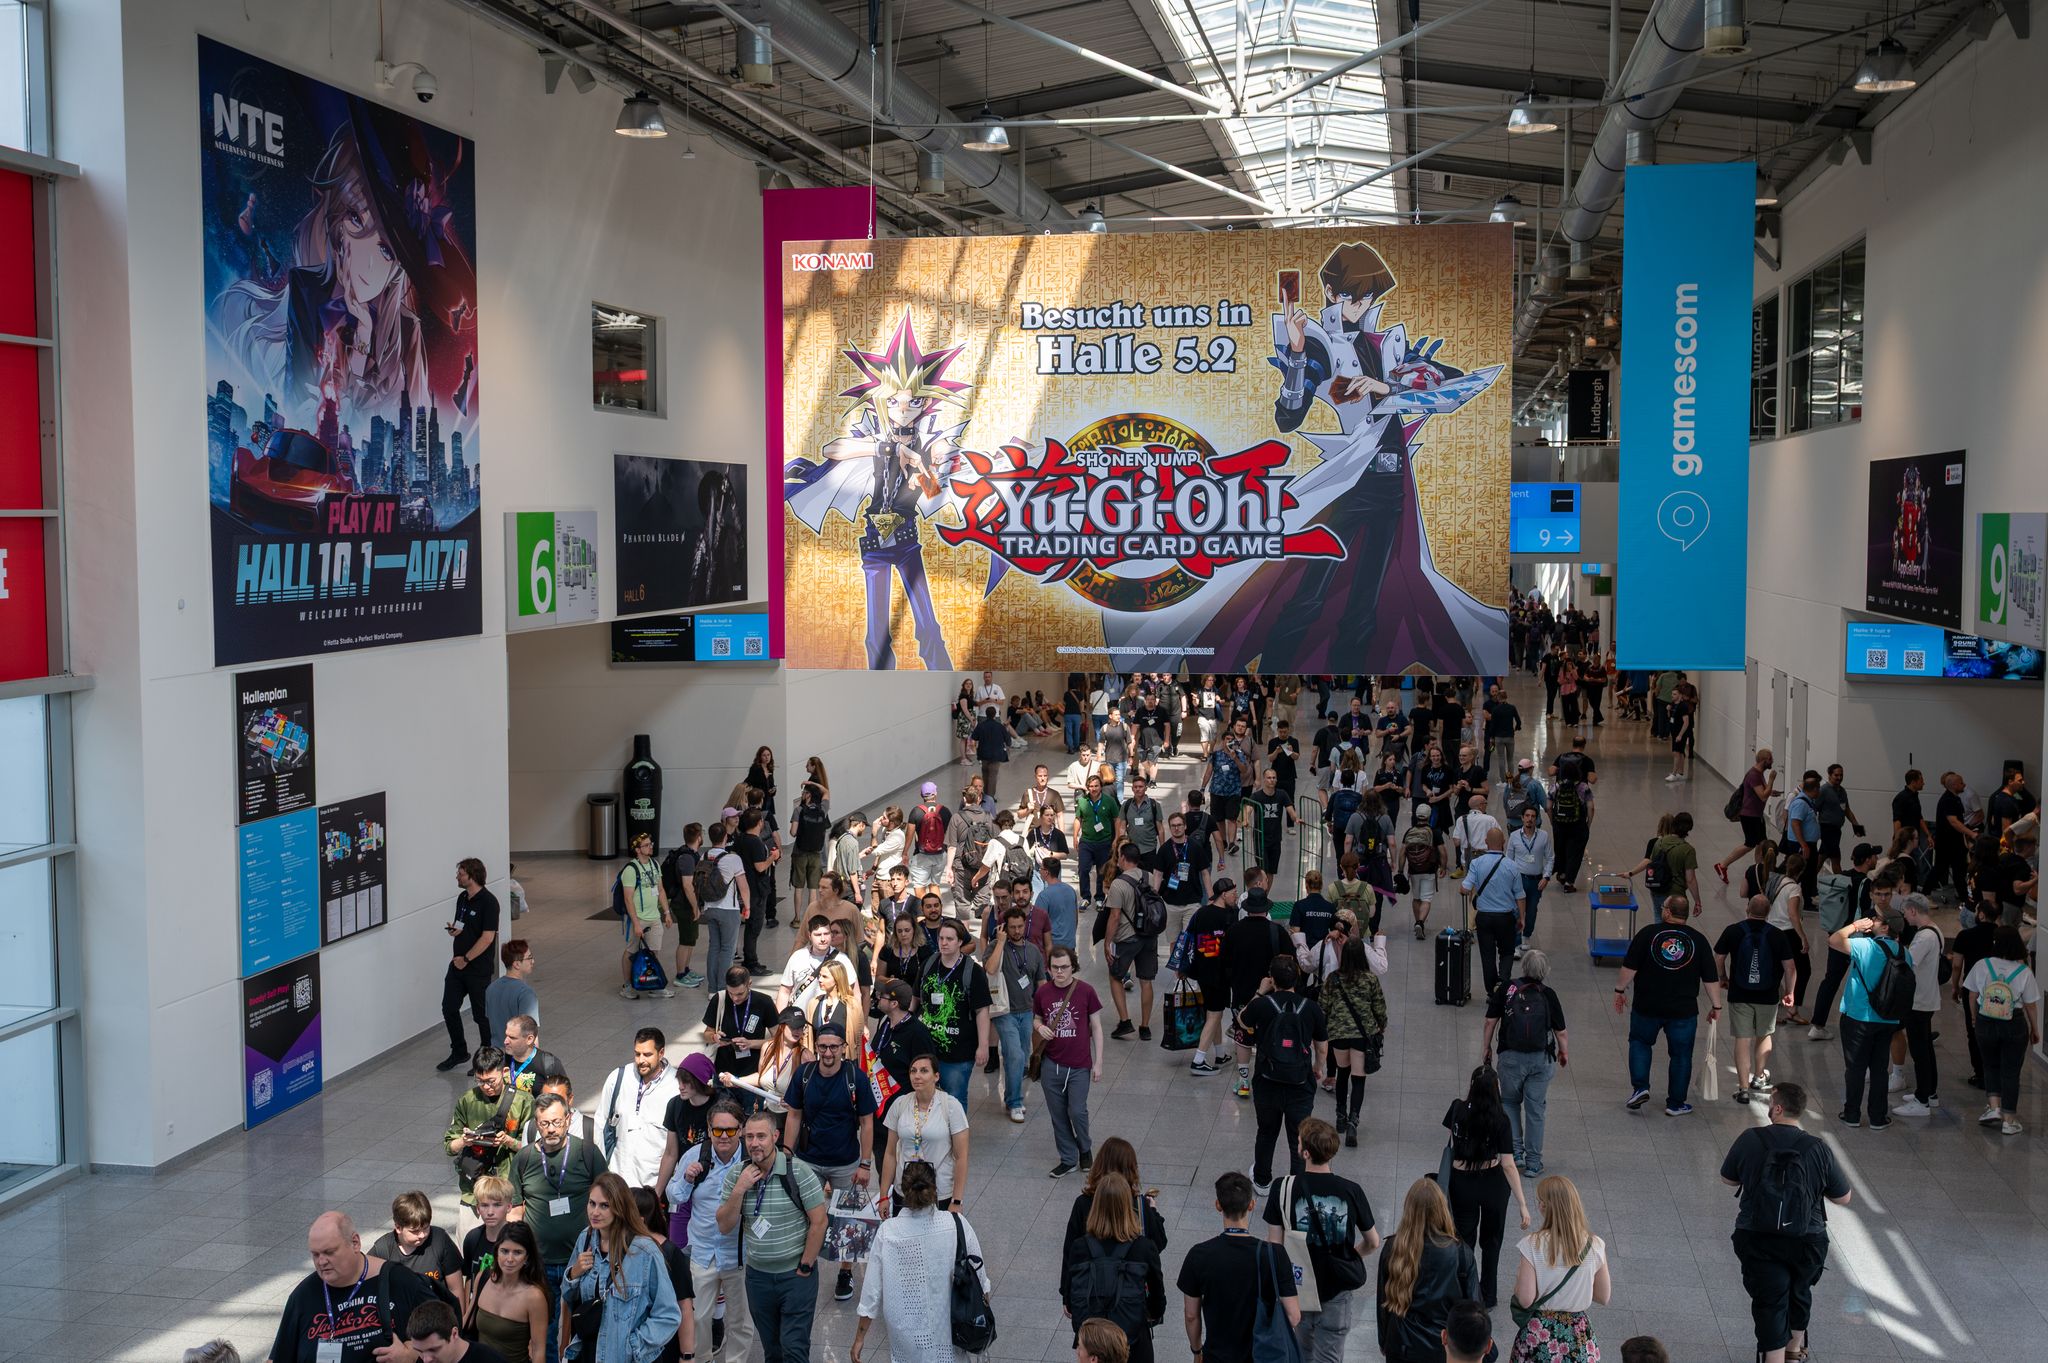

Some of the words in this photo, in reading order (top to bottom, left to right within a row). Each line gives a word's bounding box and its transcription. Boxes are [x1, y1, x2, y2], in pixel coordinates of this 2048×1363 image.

[213, 92, 285, 157] NTE
[214, 140, 247, 157] NEVERNESS
[248, 150, 256, 160] TO
[257, 153, 284, 168] EVERNESS
[792, 252, 874, 271] KONAMI
[1020, 300, 1146, 330] Besucht
[1151, 305, 1212, 328] uns
[1217, 299, 1253, 327] in
[1036, 333, 1162, 375] Halle
[1173, 336, 1237, 374] 5.2
[1672, 283, 1703, 477] gamescom
[1591, 378, 1604, 433] Lindbergh
[1076, 453, 1148, 468] SHONEN
[1150, 451, 1200, 468] JUMP
[989, 475, 1296, 537] Yu-Gi-Oh!
[327, 502, 375, 535] PLAY
[373, 501, 396, 533] AT
[623, 533, 656, 544] PHANTOM
[658, 532, 679, 543] BLADE
[1000, 535, 1117, 558] TRADING
[1123, 535, 1197, 557] CARD
[1202, 534, 1283, 557] GAME
[1539, 528, 1551, 547] 9
[235, 542, 315, 606] HALL
[531, 539, 552, 614] 6
[1897, 559, 1921, 580] AppGallery
[624, 589, 640, 602] HALL
[639, 584, 645, 600] 6
[1990, 543, 2006, 624] 9
[300, 607, 348, 622] WELCOME
[354, 606, 365, 616] TO
[372, 601, 424, 615] HETHEREAU
[340, 636, 354, 645] Studio,
[358, 634, 373, 642] Perfect
[374, 633, 385, 641] World
[1077, 646, 1095, 654] Studio
[1158, 646, 1185, 655] TOKYO,
[1185, 647, 1215, 655] KONAMI
[242, 688, 287, 705] Hallenplan
[932, 1023, 959, 1035] JONES
[1060, 1029, 1076, 1037] ROLL
[302, 1059, 315, 1073] epix
[338, 1296, 364, 1312] DENIM
[362, 1328, 383, 1338] GARMENT
